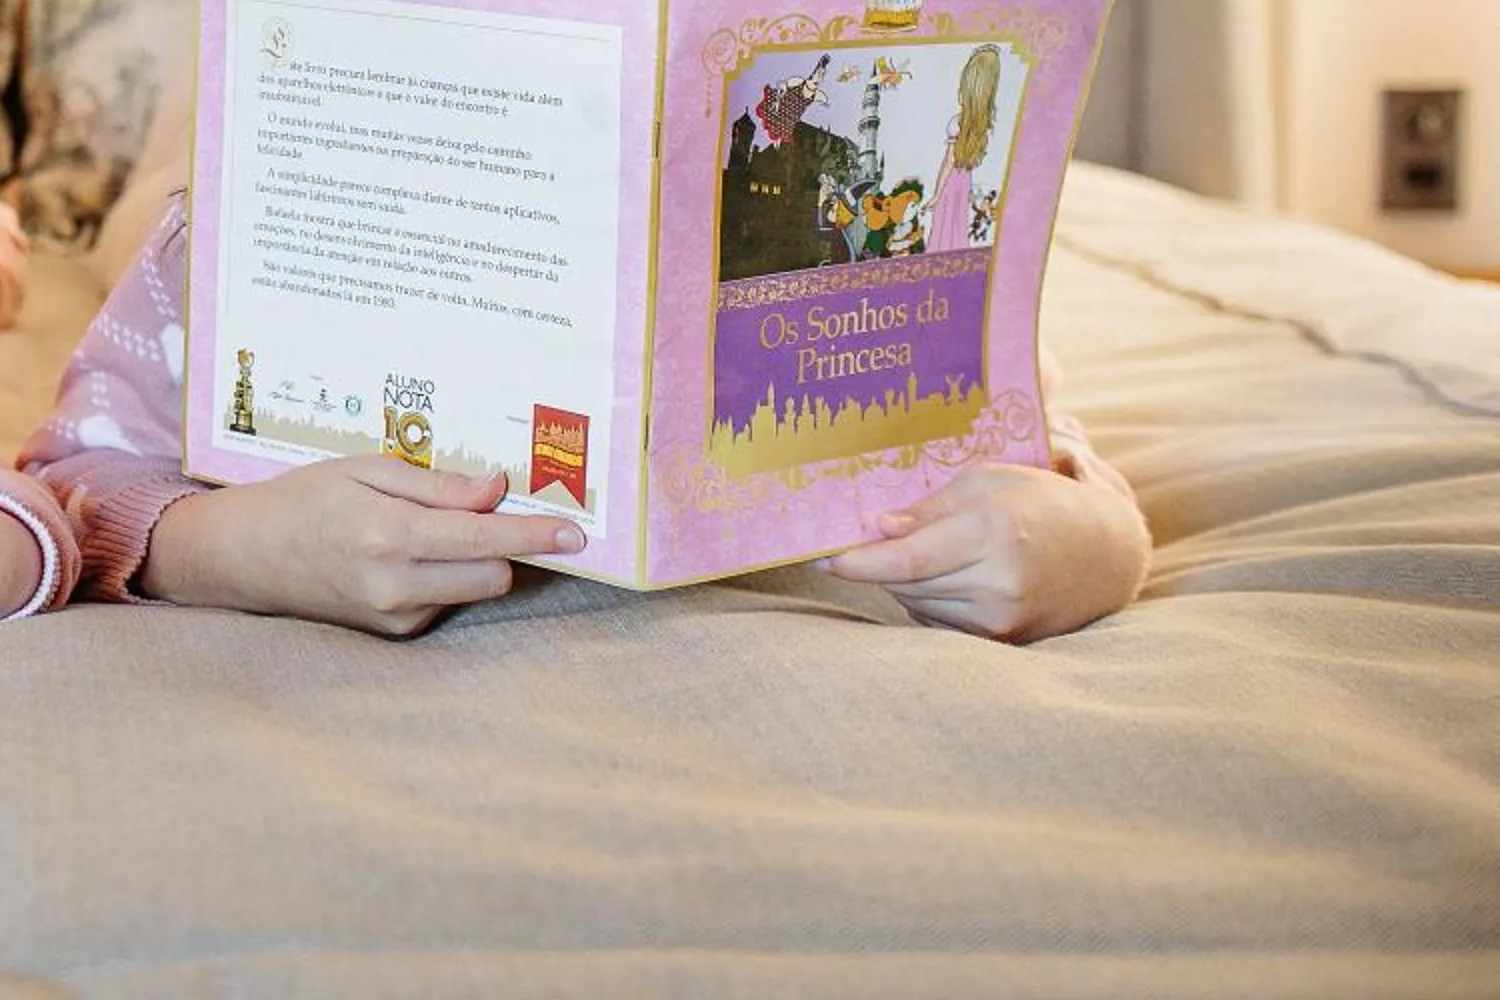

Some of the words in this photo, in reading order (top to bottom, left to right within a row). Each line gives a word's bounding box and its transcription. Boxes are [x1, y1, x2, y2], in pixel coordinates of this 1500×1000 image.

[759, 313, 799, 349] Os
[807, 297, 909, 341] Sonhos
[916, 288, 949, 324] da
[385, 373, 435, 394] ALUNO
[797, 342, 912, 384] Princesa
[384, 387, 434, 413] NOTA
[384, 407, 433, 457] 10
